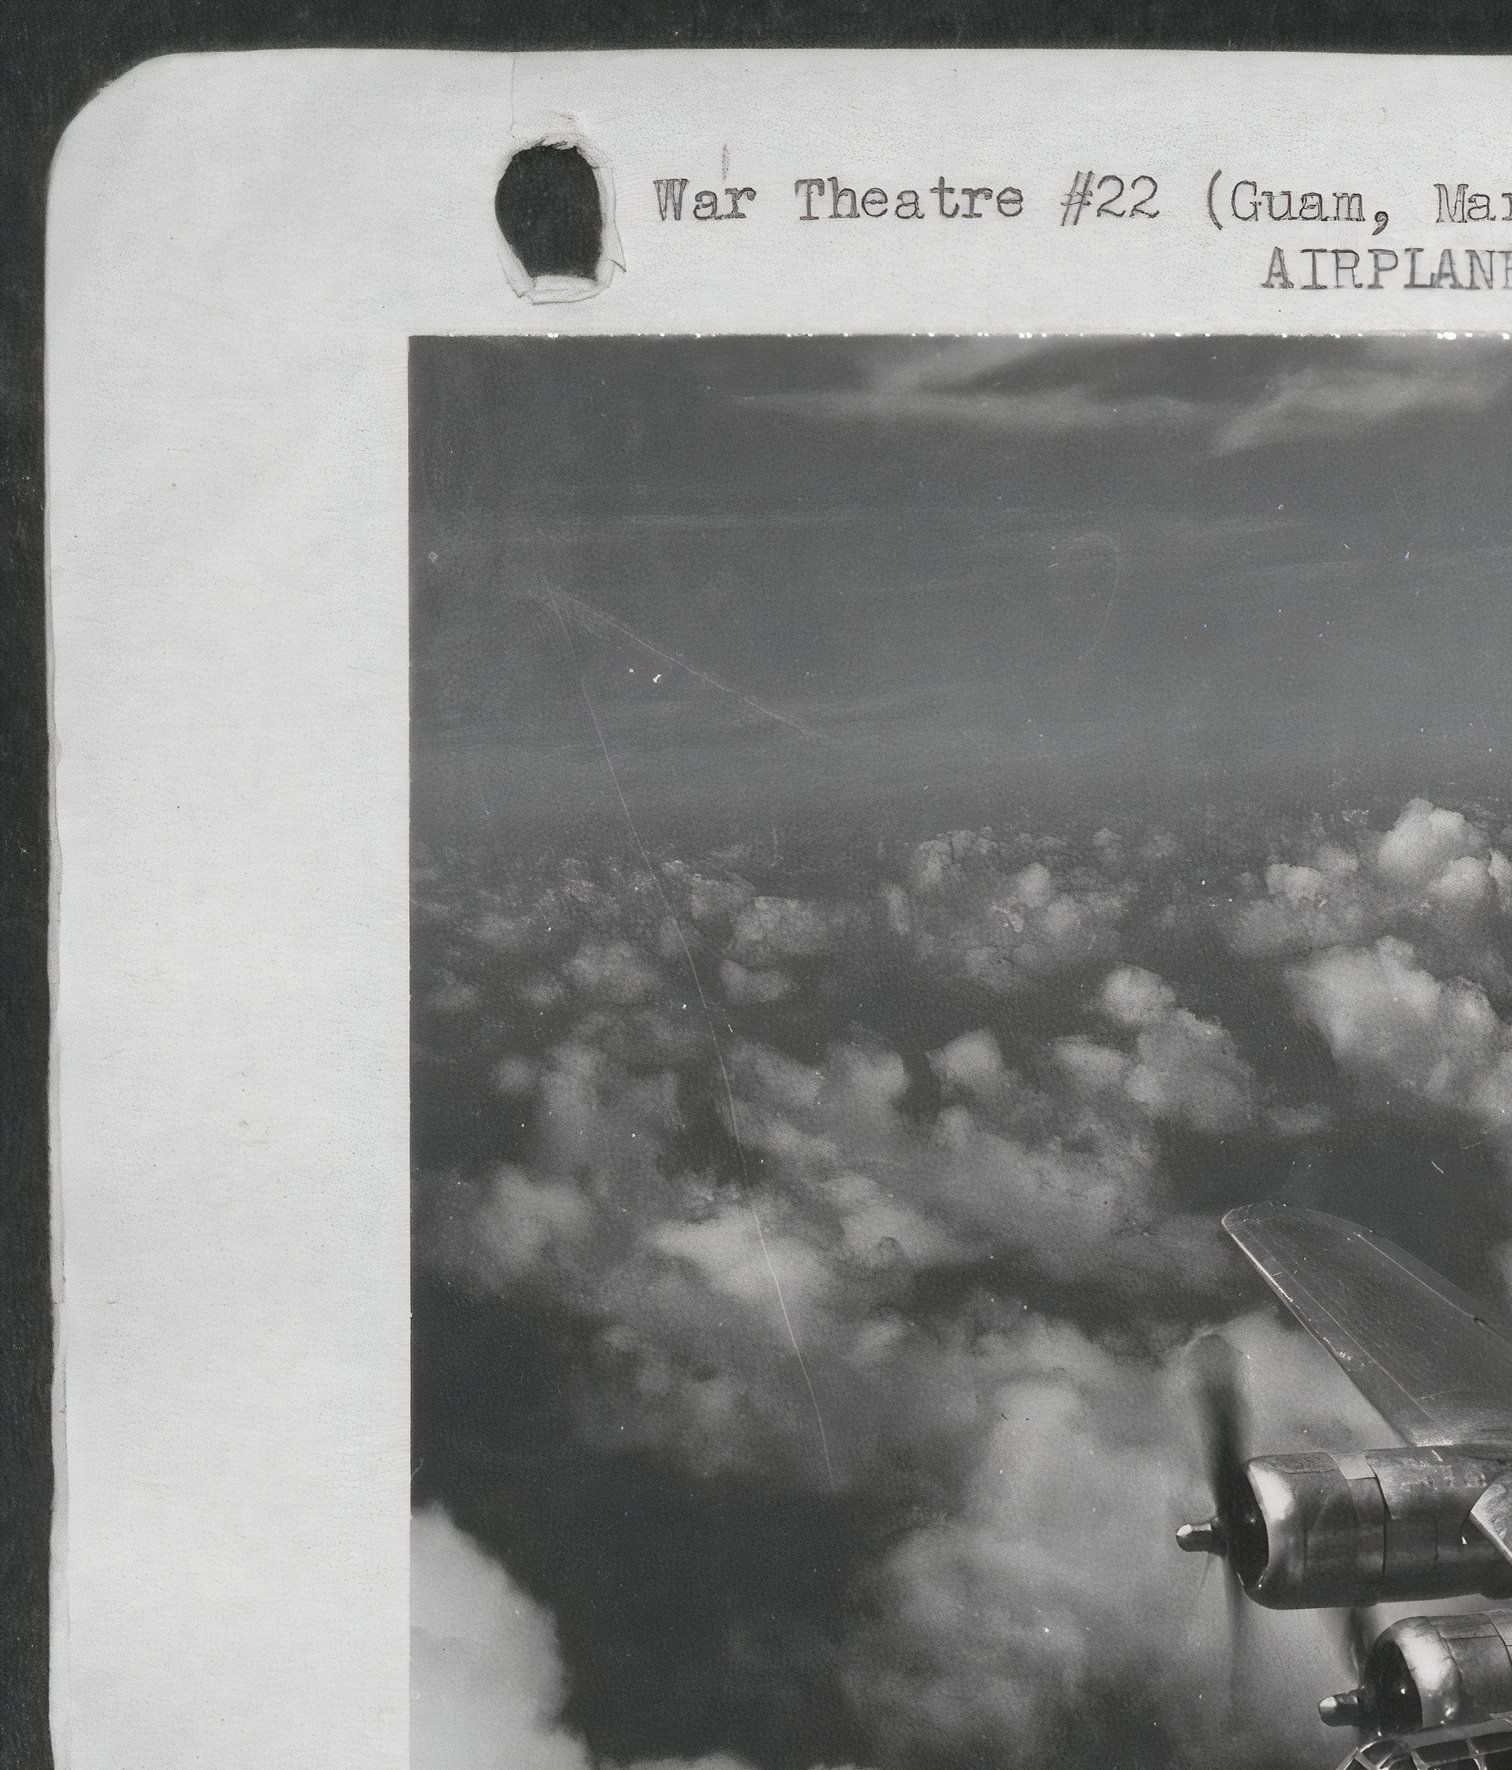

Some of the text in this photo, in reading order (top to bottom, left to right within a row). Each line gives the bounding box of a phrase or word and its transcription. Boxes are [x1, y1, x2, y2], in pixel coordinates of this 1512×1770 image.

[653, 178, 757, 221] War
[795, 175, 1023, 221] Theatre
[1061, 170, 1162, 226] #22
[1205, 170, 1391, 236] (Guam,
